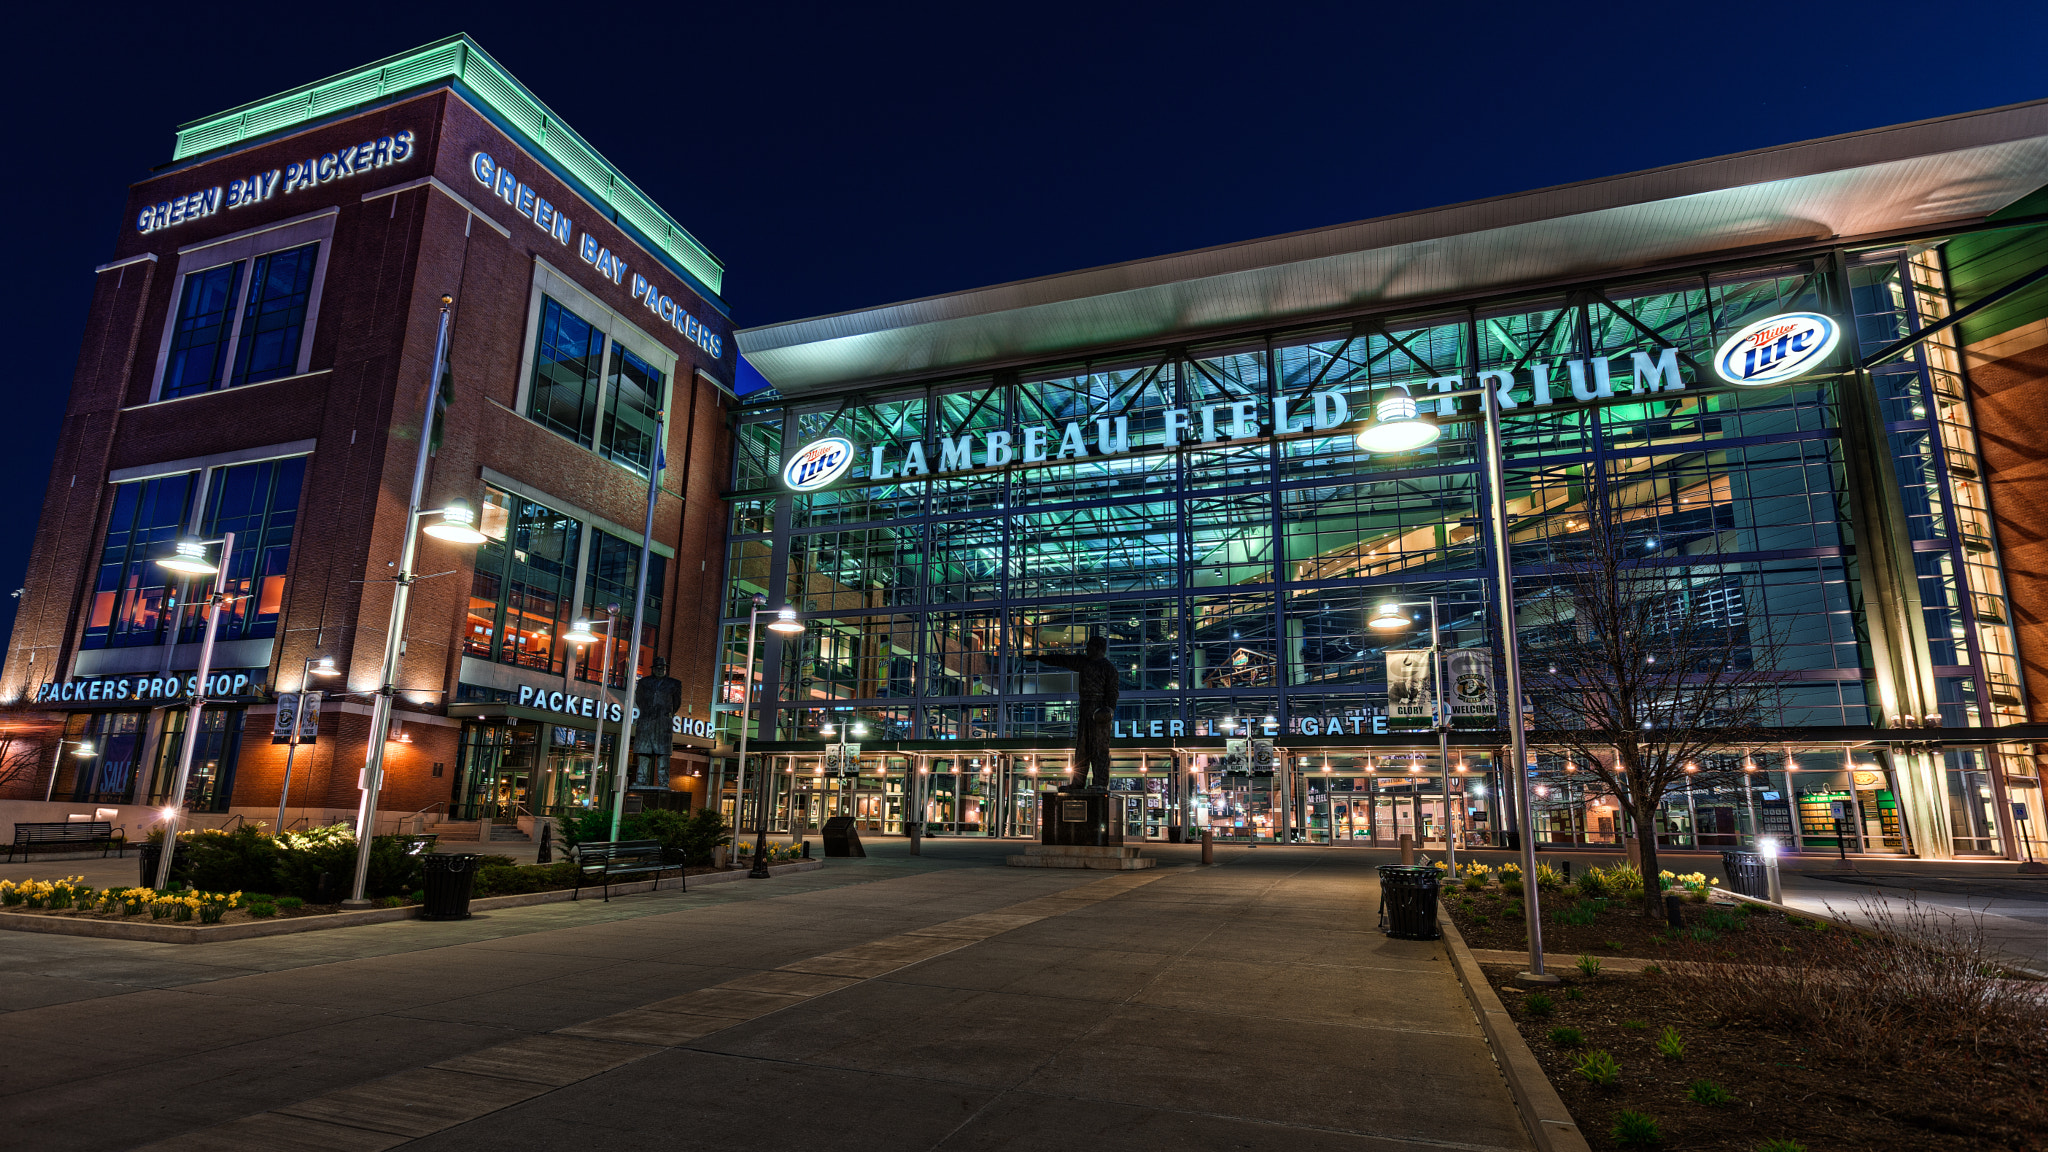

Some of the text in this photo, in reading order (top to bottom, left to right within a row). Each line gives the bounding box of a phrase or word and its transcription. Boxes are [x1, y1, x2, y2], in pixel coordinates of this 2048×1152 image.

[136, 129, 415, 234] GREEN BAY PACKERS
[472, 152, 723, 359] GREEN BAY PACKERS
[1746, 322, 1799, 348] Miller
[1742, 328, 1815, 380] Lite
[870, 415, 1131, 480] LAMBEAU
[1163, 391, 1348, 447] FIELD
[797, 450, 841, 486] Lite
[804, 445, 834, 462] Miller
[37, 674, 248, 702] PACKERS PRO SHOP
[519, 684, 622, 723] PACKERS
[672, 715, 715, 738] SHOP
[1397, 706, 1424, 715] GLORY
[1451, 704, 1495, 714] WELCOME
[1114, 719, 1185, 738] LLER
[1300, 716, 1389, 736] GATE
